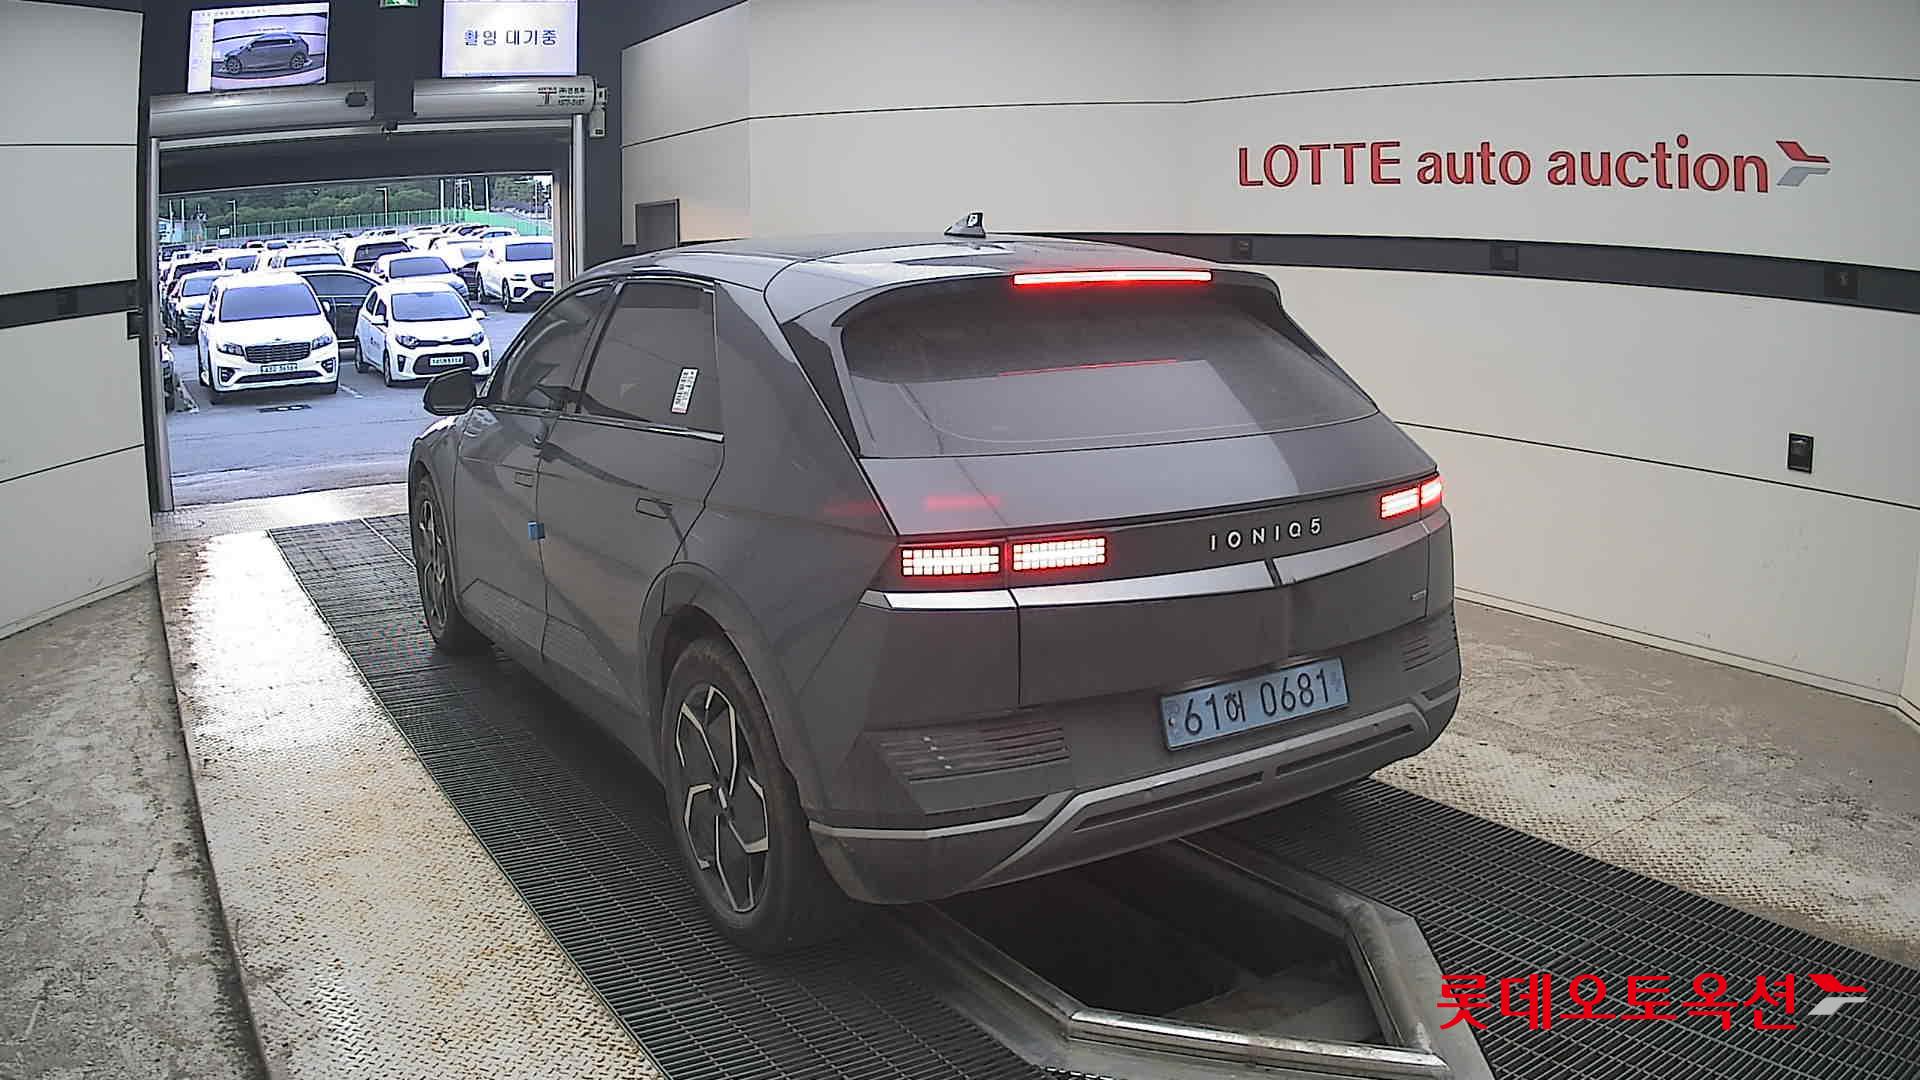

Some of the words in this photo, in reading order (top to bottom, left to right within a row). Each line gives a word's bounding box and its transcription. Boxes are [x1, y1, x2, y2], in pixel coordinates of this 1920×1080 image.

[505, 29, 557, 46] 대기중
[1238, 141, 1400, 187] LOTTE
[1416, 142, 1531, 185] auto
[1547, 134, 1769, 193] auction
[1260, 668, 1329, 718] 0681
